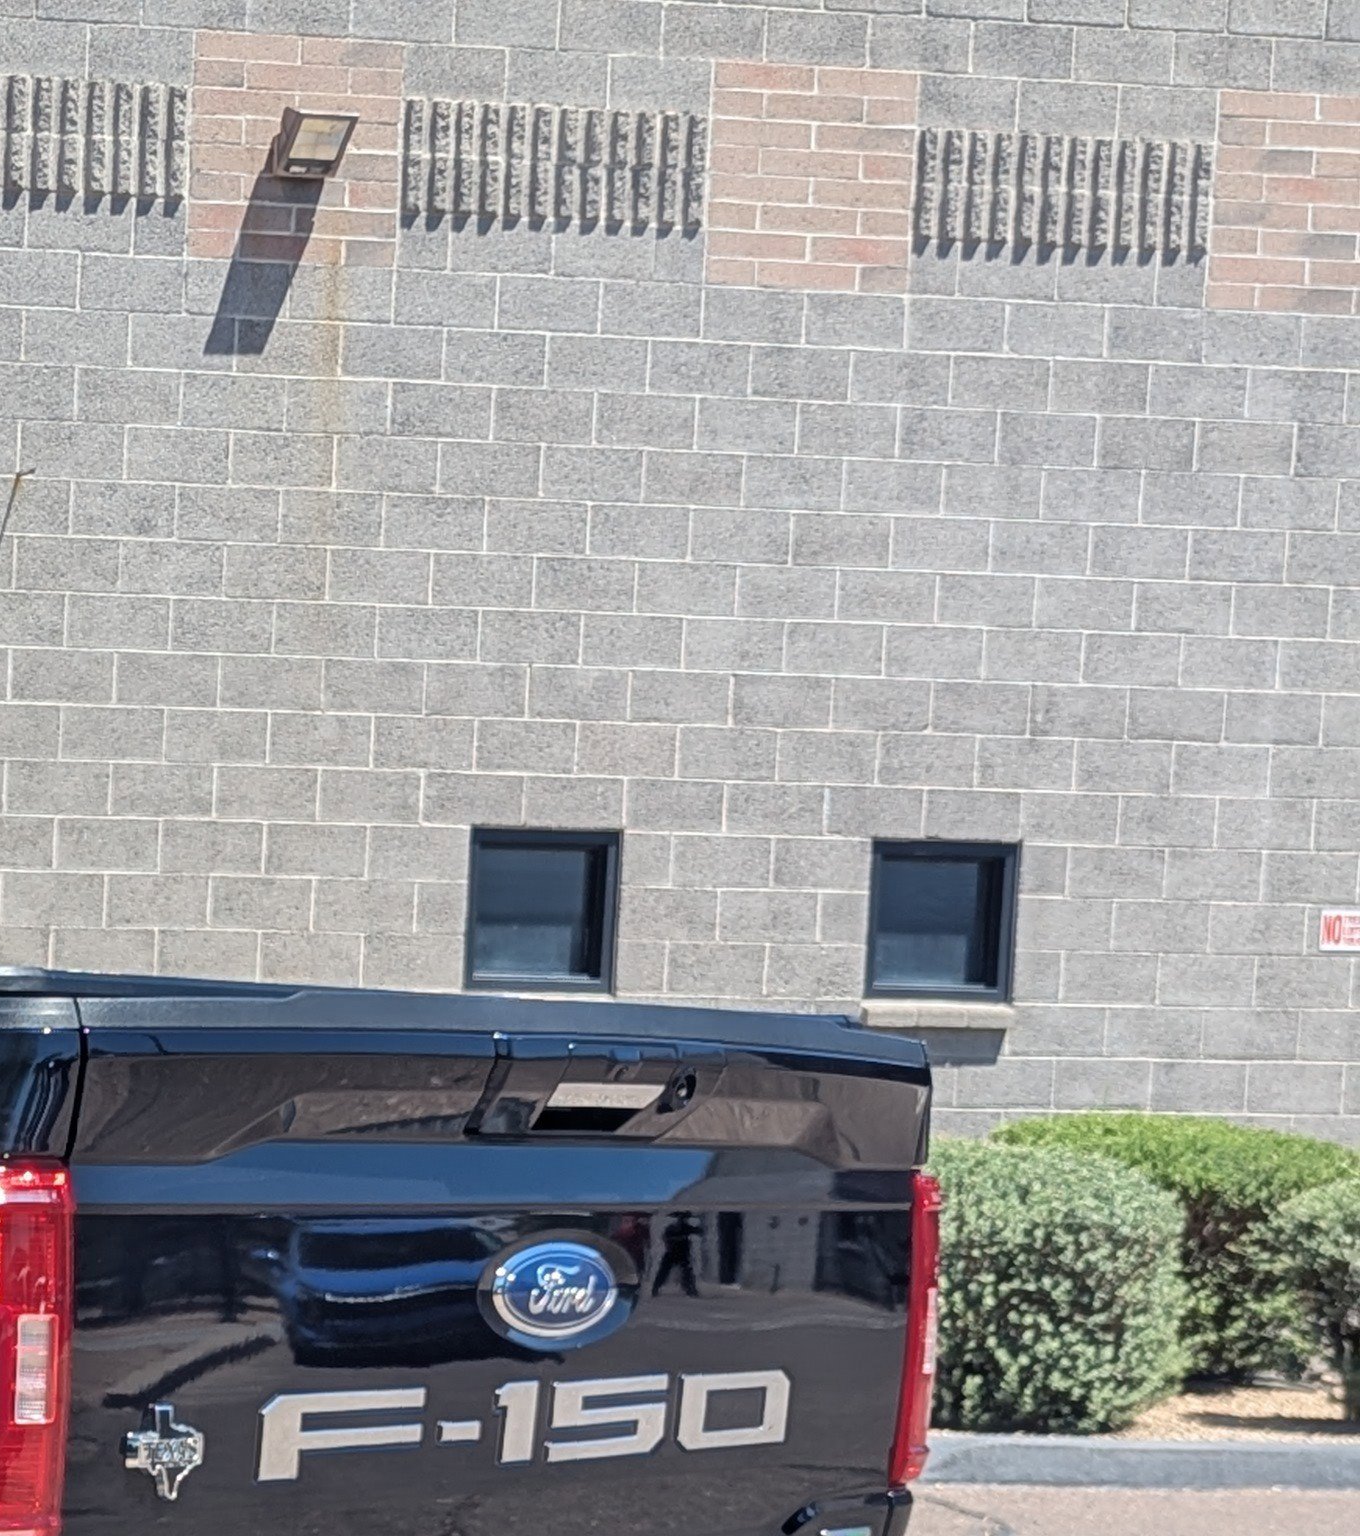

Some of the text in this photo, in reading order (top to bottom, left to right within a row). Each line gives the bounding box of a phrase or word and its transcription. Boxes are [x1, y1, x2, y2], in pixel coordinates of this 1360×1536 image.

[1321, 914, 1342, 945] NO
[528, 1261, 598, 1315] Ford
[253, 1367, 792, 1484] F-150
